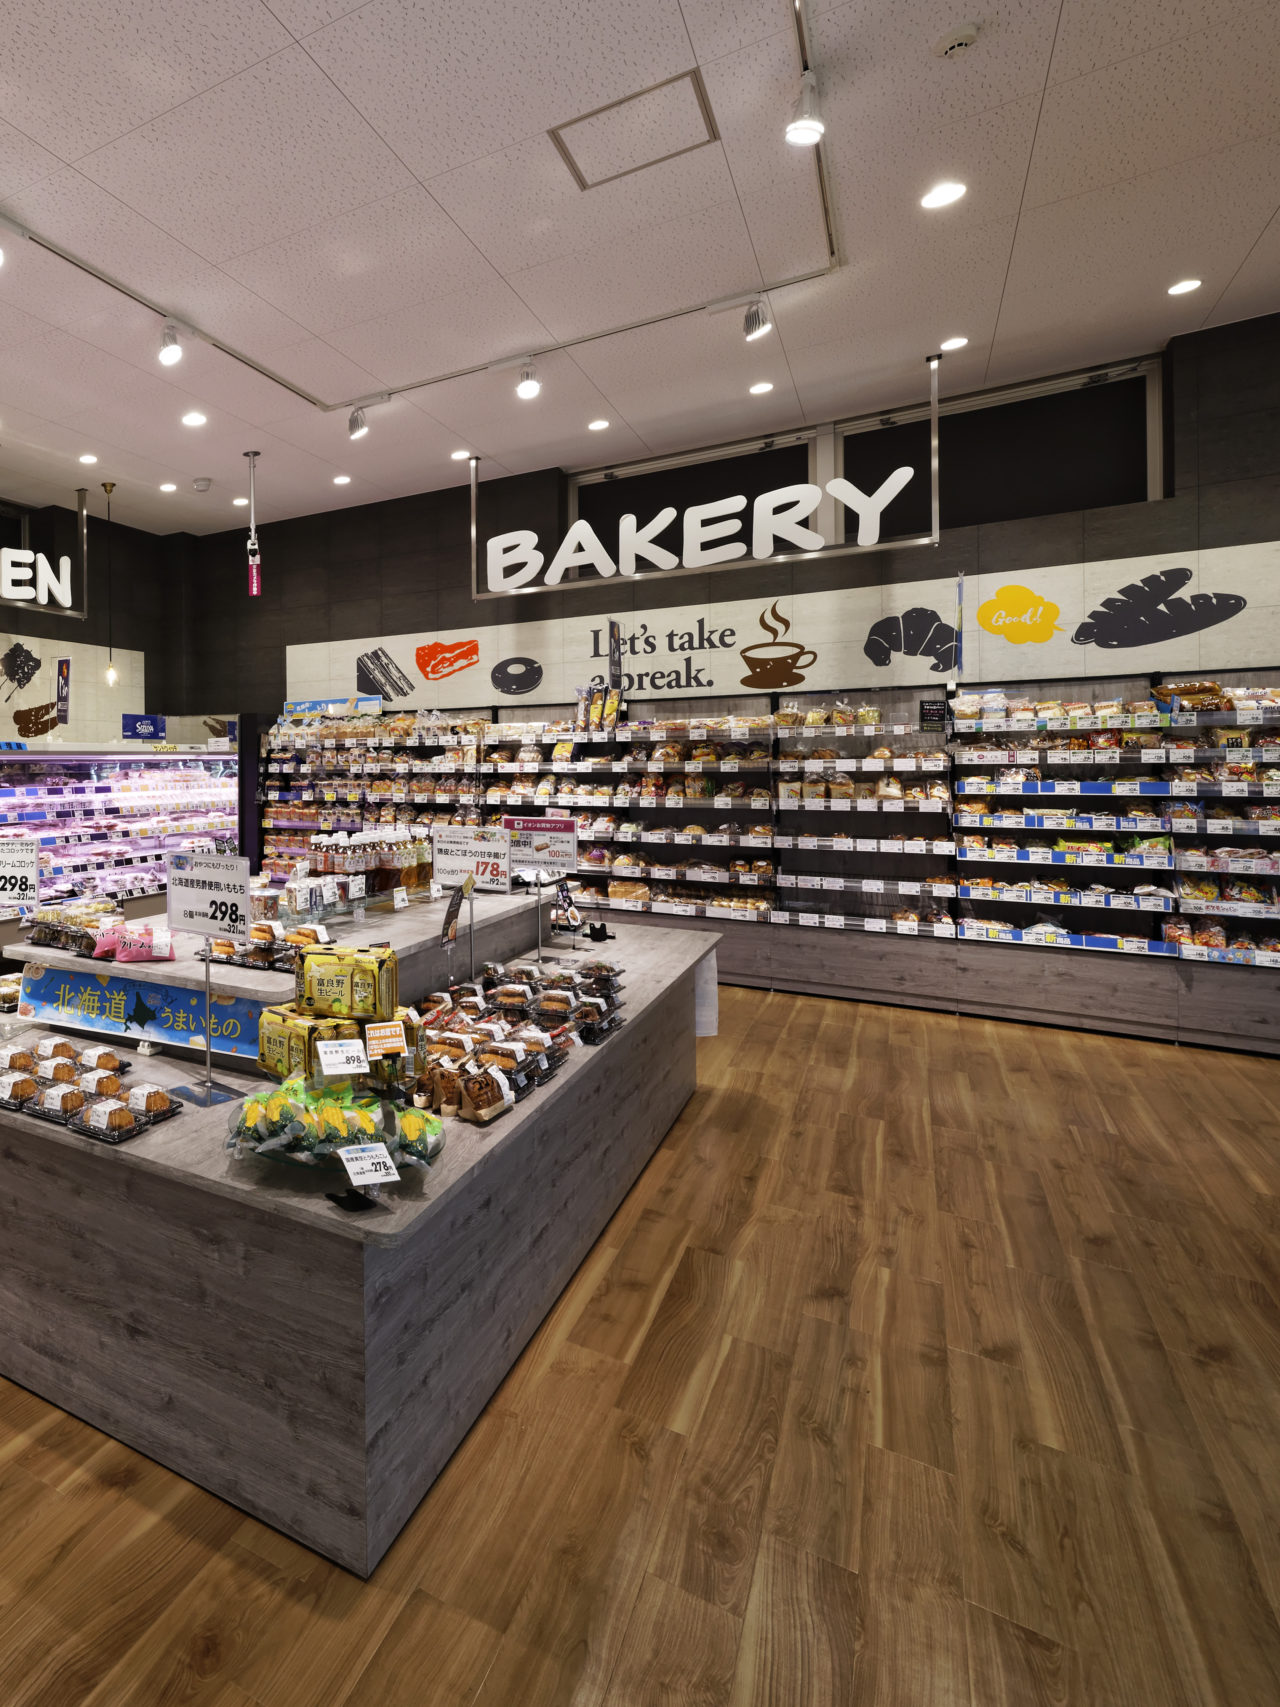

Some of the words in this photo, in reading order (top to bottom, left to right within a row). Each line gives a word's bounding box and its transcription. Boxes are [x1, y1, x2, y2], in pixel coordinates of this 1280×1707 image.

[486, 466, 915, 593] BAKERY
[991, 606, 1044, 626] Good!
[665, 617, 737, 653] take
[475, 861, 507, 878] 178円
[209, 900, 246, 926] 298円
[316, 978, 345, 988] 富良野
[317, 988, 345, 997] 生ビール
[53, 984, 128, 1023] 北海道
[160, 1007, 242, 1038] うまいもの
